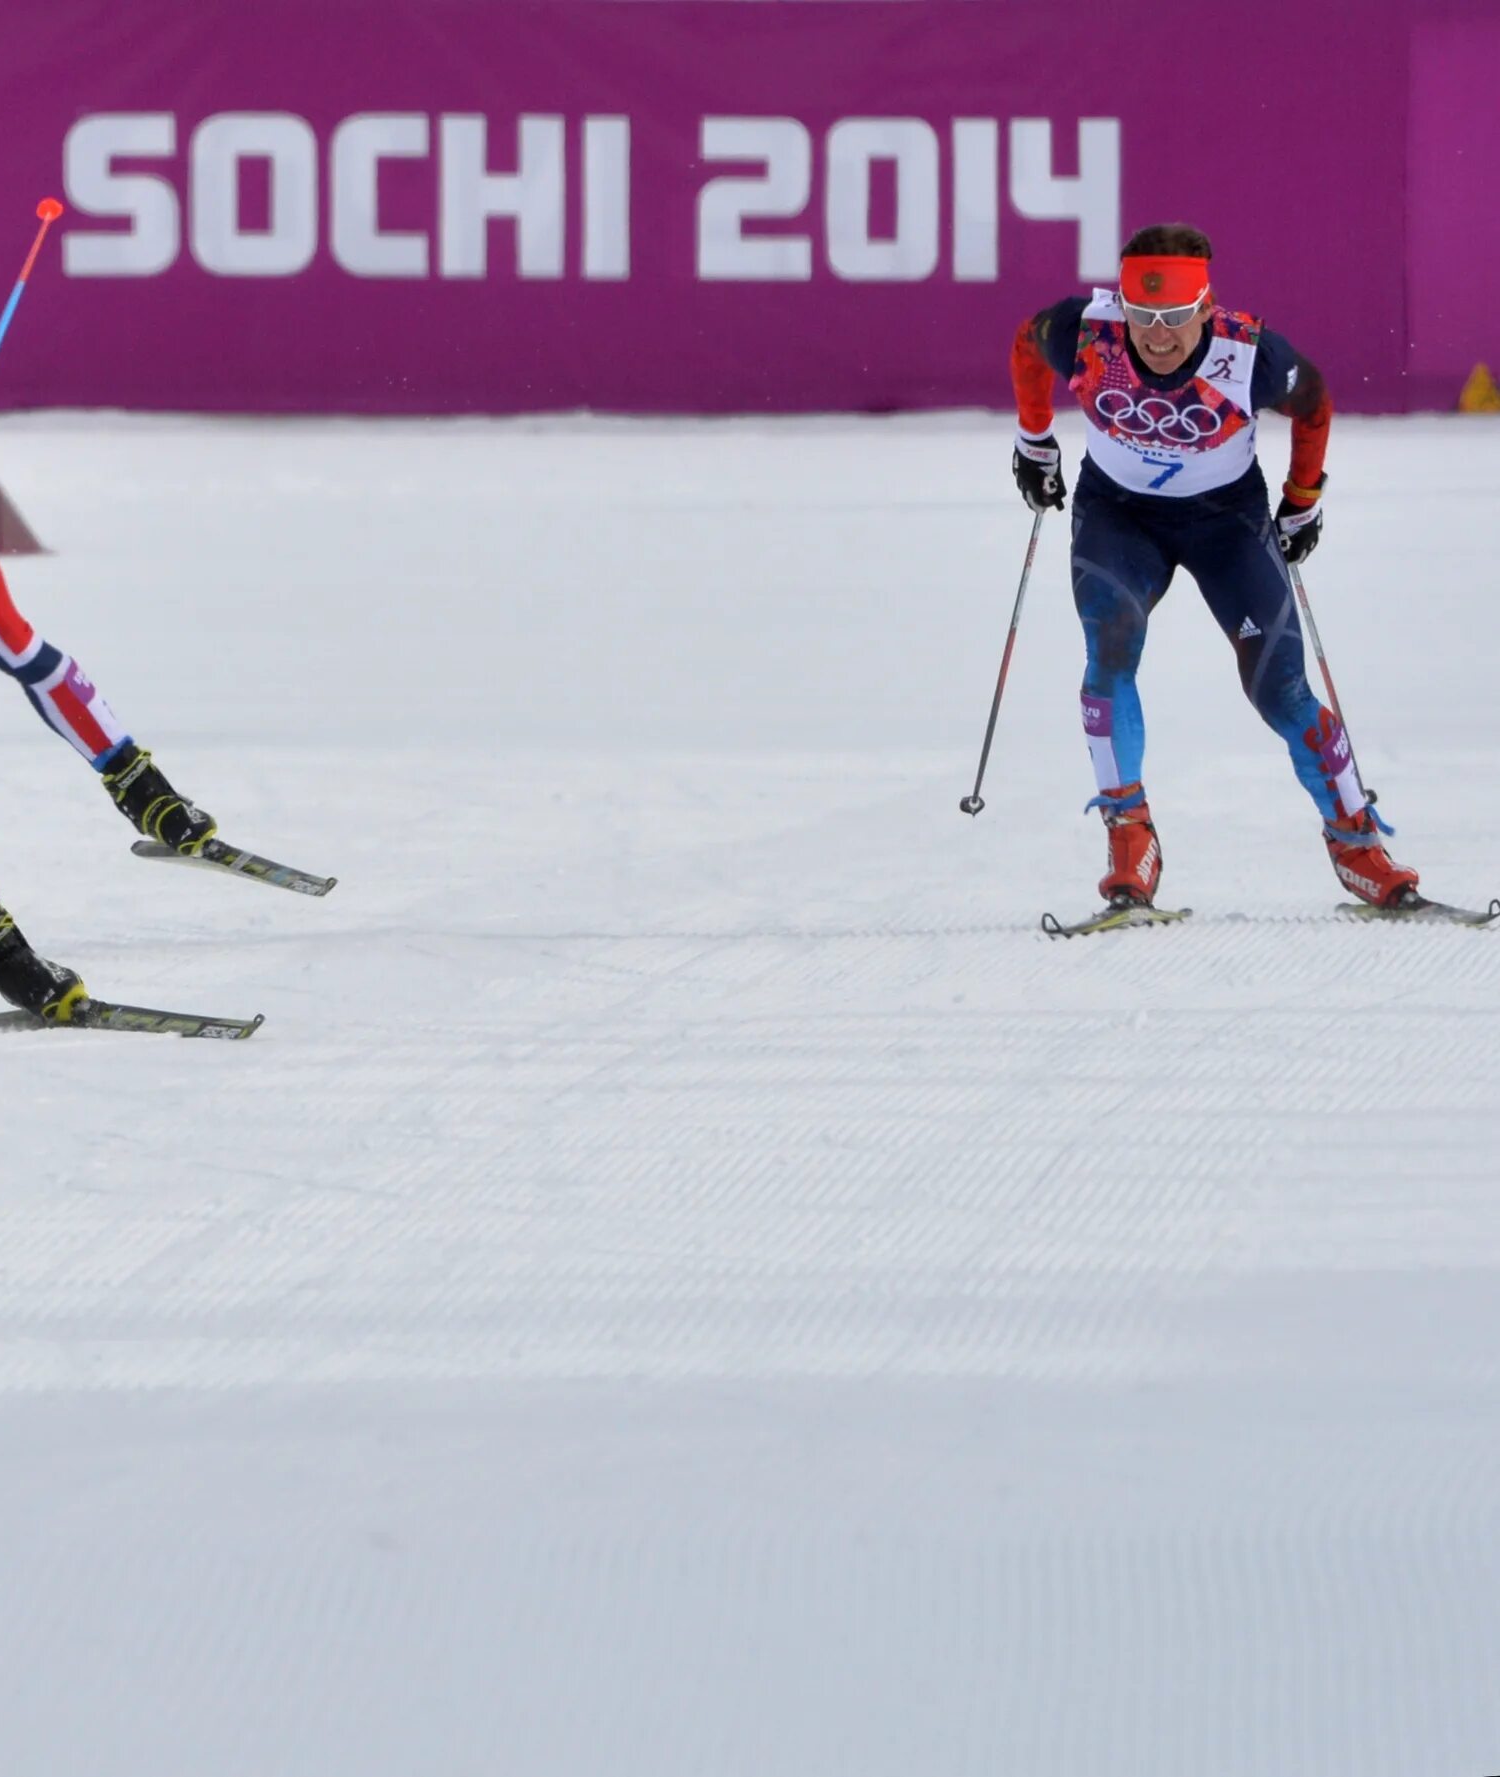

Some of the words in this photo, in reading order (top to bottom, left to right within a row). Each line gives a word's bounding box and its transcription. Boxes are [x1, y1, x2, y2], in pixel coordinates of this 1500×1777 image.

[62, 112, 631, 279] SOCHI
[698, 114, 1121, 282] 2014
[1142, 455, 1184, 490] 7
